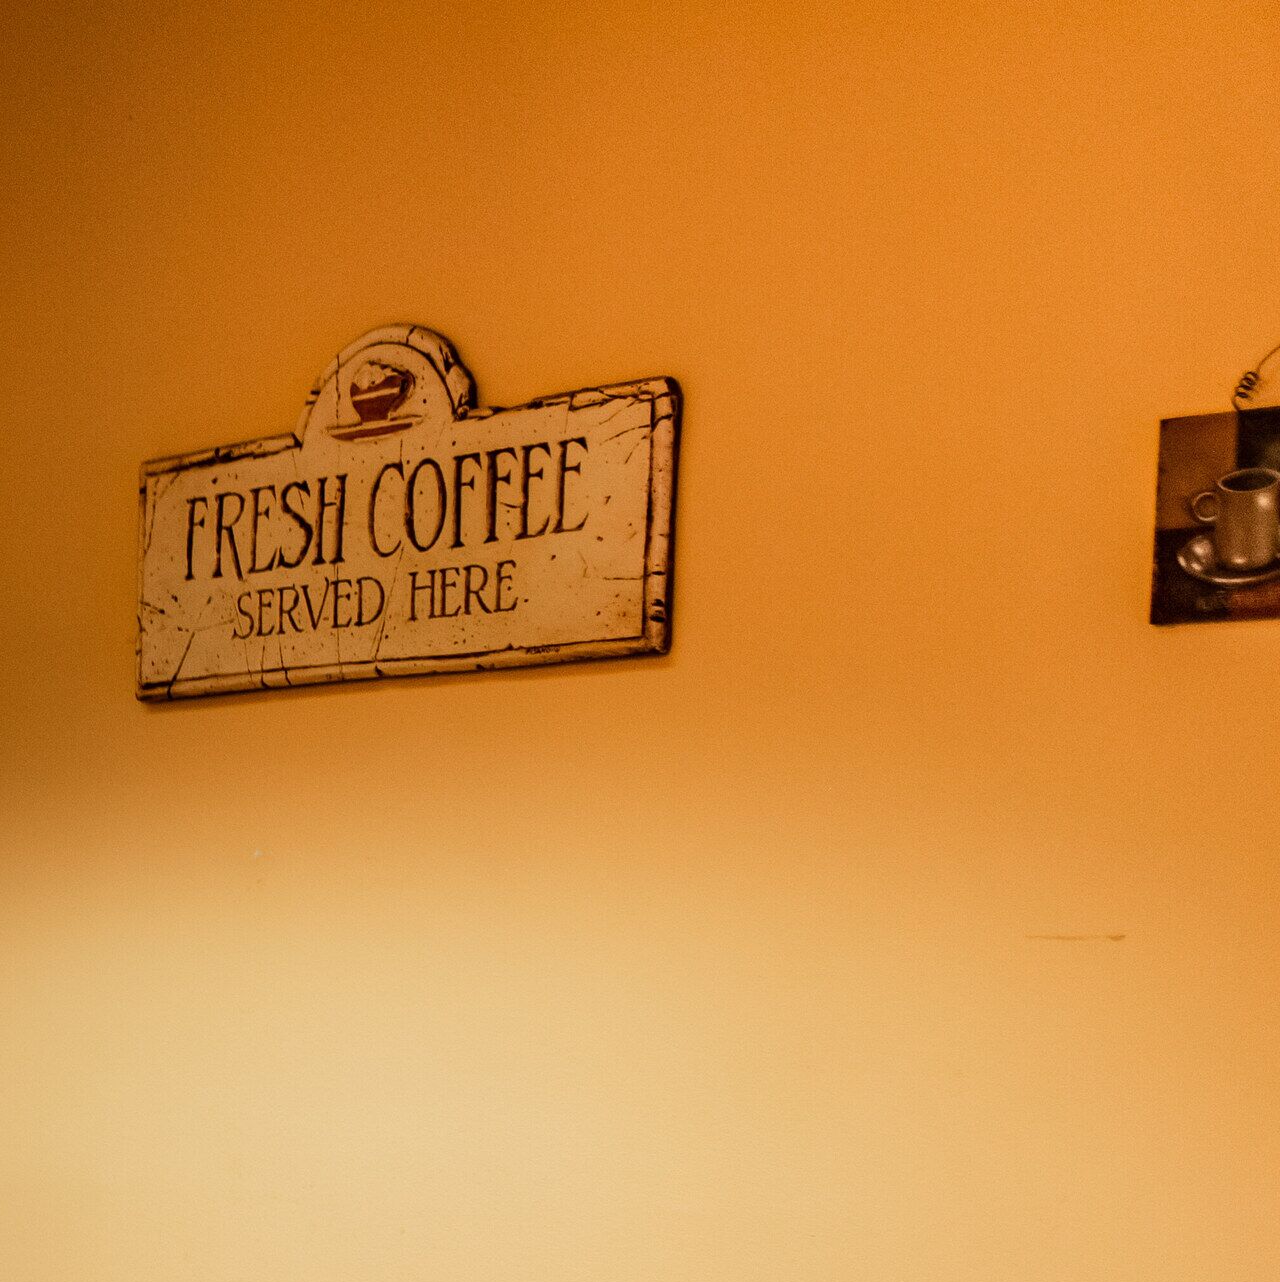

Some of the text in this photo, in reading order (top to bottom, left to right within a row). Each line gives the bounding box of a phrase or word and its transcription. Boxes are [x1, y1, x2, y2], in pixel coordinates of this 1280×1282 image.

[185, 436, 590, 582] FRESH COFFEE
[232, 560, 519, 640] SERVED HERE
